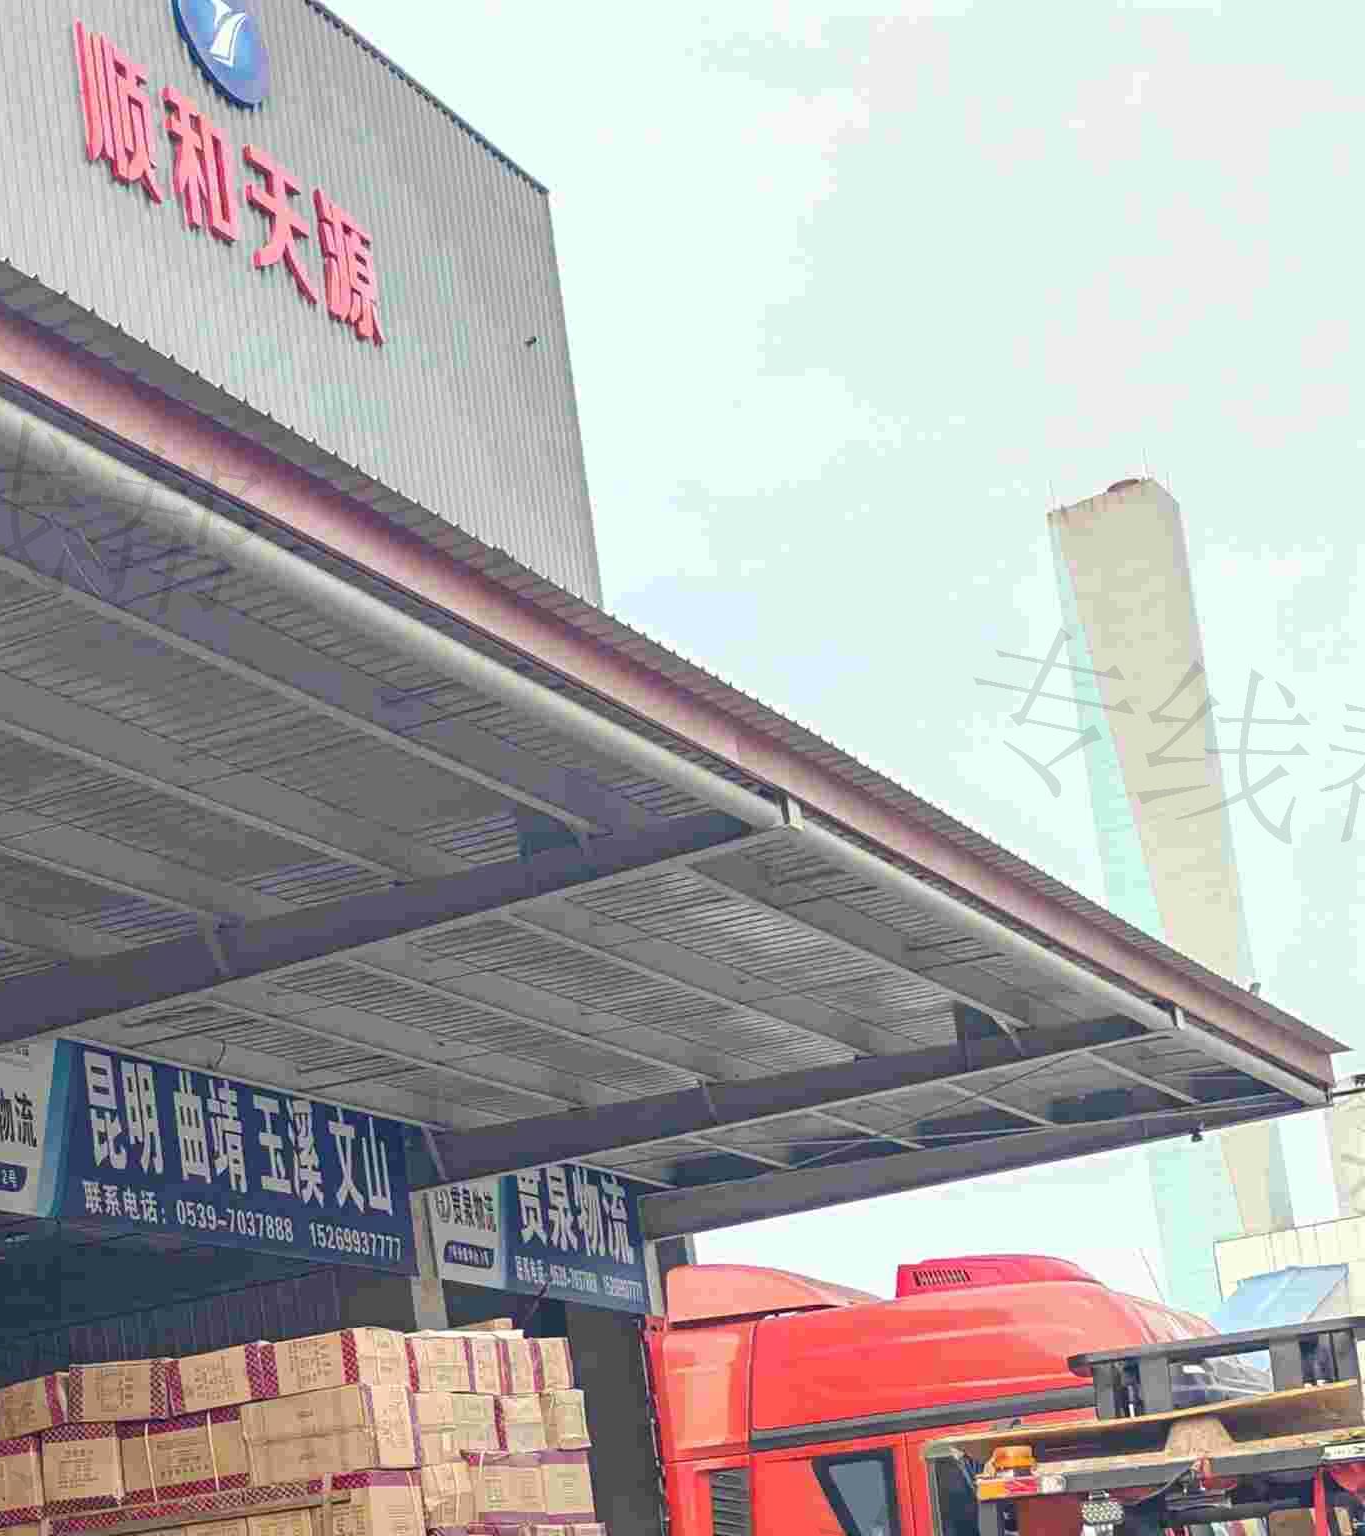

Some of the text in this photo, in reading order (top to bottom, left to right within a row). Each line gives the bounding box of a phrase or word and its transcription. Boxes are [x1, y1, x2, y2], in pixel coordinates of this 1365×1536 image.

[72, 18, 385, 347] 顺和天源
[83, 1050, 393, 1217] 昆明 曲靖 玉溪 文山
[176, 1200, 294, 1243] 0539-7037888
[308, 1221, 402, 1261] 15269937777
[517, 1166, 634, 1264] 贯泉物流
